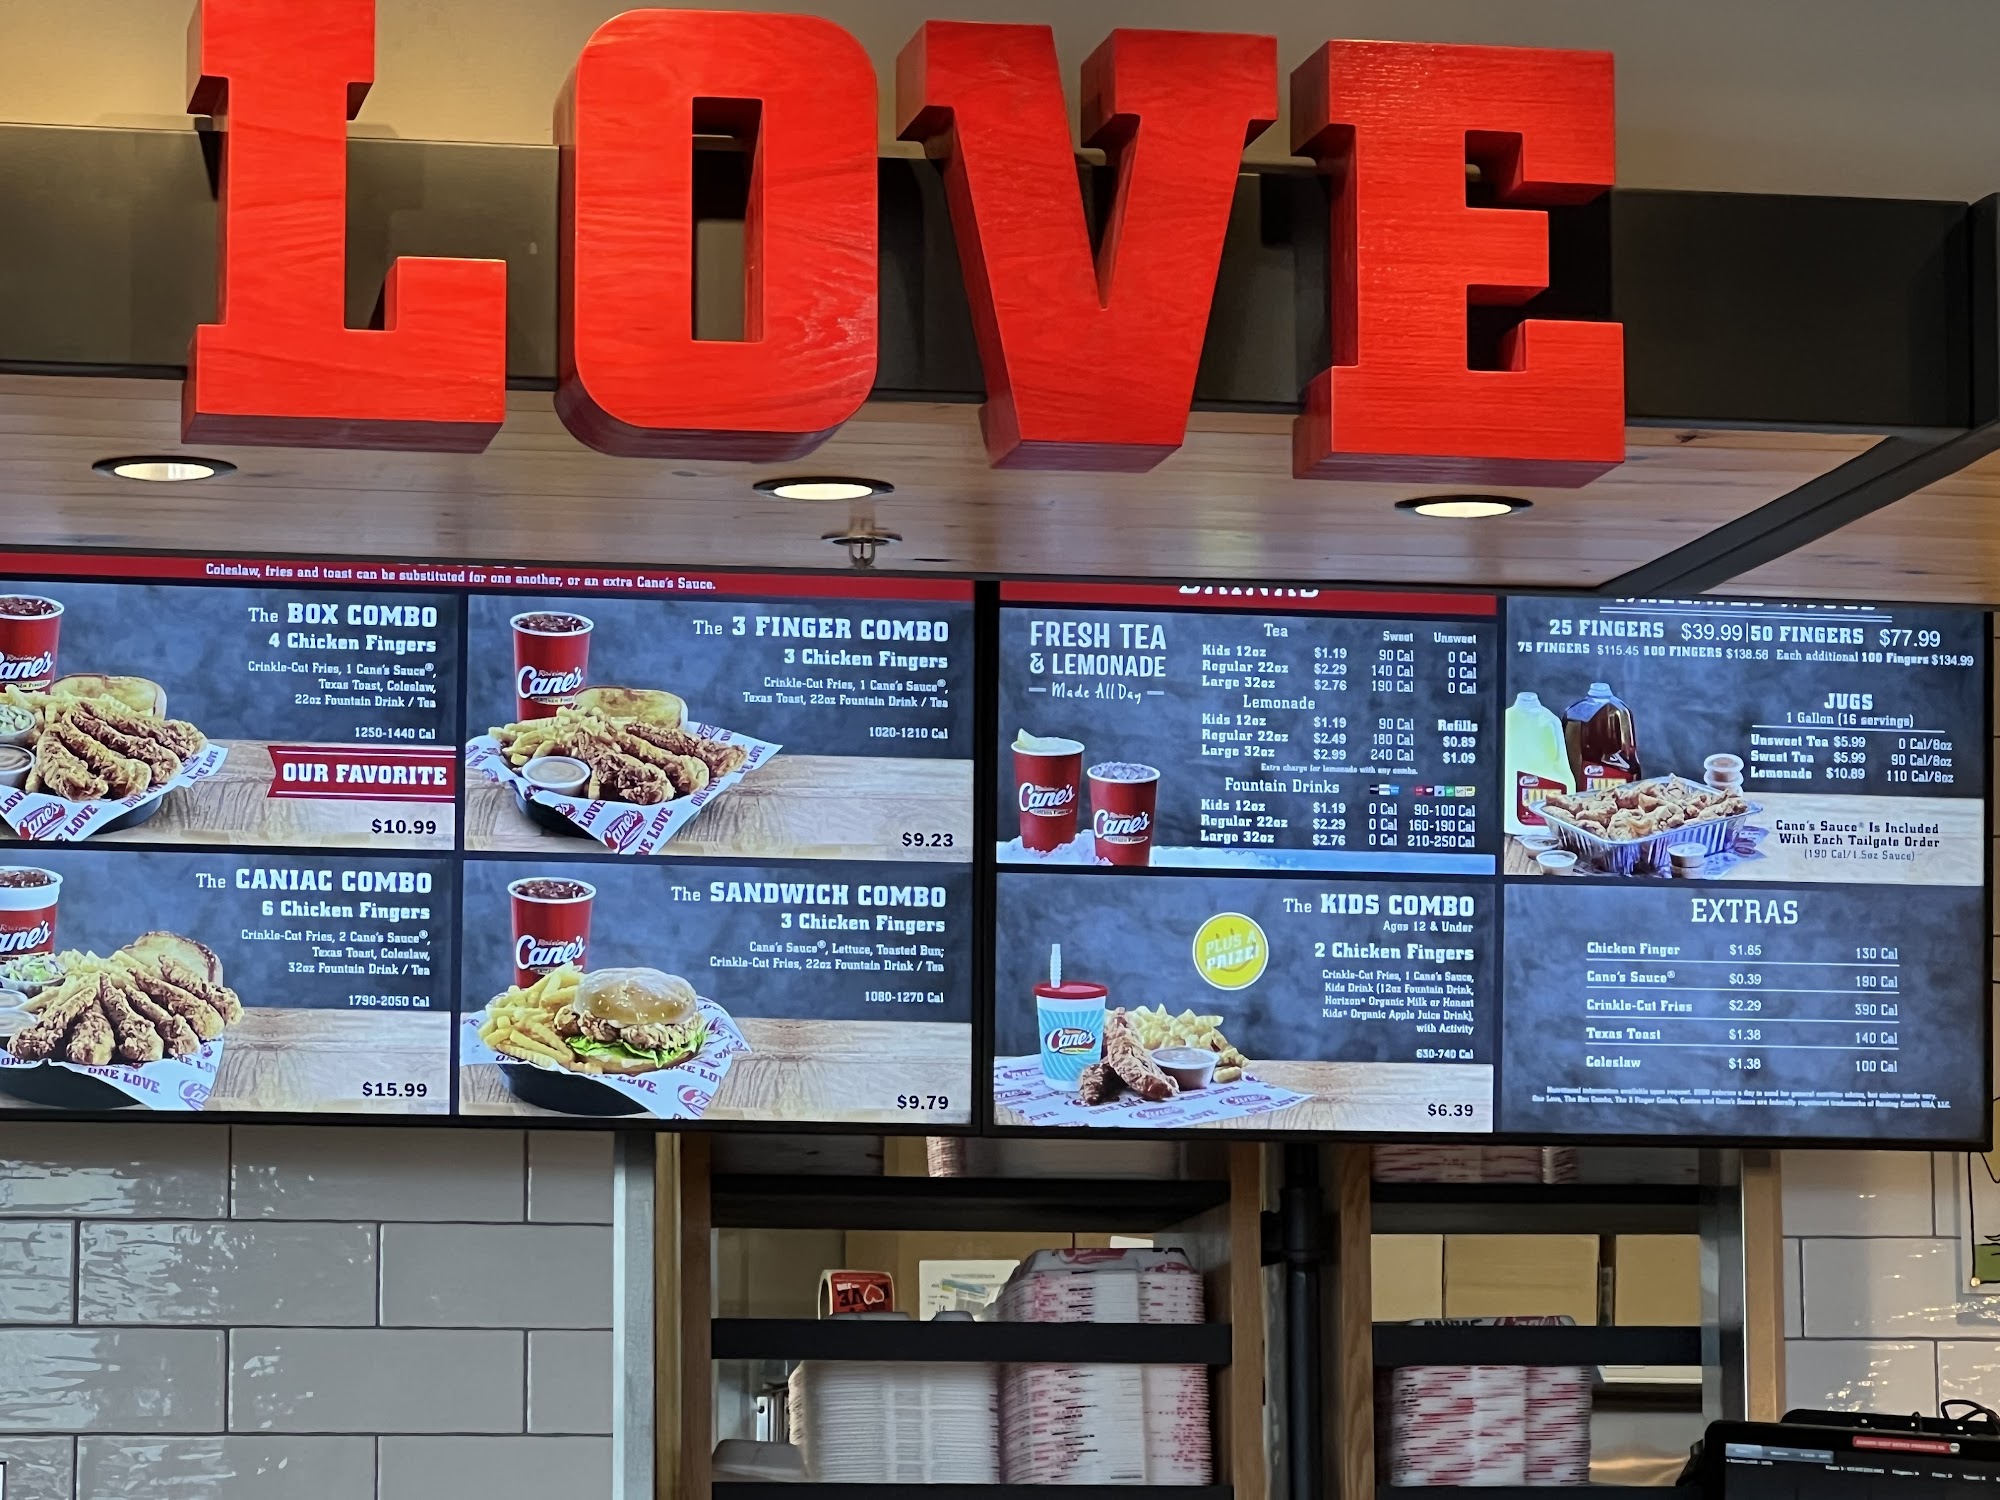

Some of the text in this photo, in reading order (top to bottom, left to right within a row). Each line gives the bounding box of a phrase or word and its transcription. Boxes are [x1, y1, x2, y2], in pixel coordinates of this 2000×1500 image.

[180, 0, 1626, 488] LOVE
[206, 563, 716, 590] Coleslaw, fries and toast can be substituted for one another, or an extra Cane's Sauce.
[248, 603, 438, 627] The BOX COMBO
[693, 616, 949, 642] The 3 FINGER COMBO
[1030, 621, 1166, 650] FRESH TEA
[1264, 623, 1288, 638] Tea
[1550, 619, 1664, 638] 25 FINGERS
[1682, 622, 1742, 642] $39.99
[1750, 625, 1941, 648] 50 FINGERS $77.99
[269, 632, 436, 655] 4 Chicken Fingers
[248, 661, 308, 673] Crinkle-Cut
[312, 663, 342, 675] Fries,
[346, 664, 352, 674] 1
[356, 664, 390, 676] Cane's
[784, 649, 948, 672] 3 Chicken Fingers
[1030, 652, 1166, 677] & LEMONADE
[1202, 660, 1476, 680] Regular 22oz $2.29 140 Cal 0 Cal
[318, 679, 437, 694] Texas Toast, Coleslaw,
[517, 666, 583, 698] Cane's
[1052, 682, 1142, 704] Made All Day
[1824, 693, 1873, 710] JUGS
[1243, 695, 1316, 710] Lemonade
[1438, 719, 1478, 732] Refills
[1786, 712, 1914, 729] 1 Gallon (16 servings)
[356, 727, 436, 740] 1250-1440 Cal
[869, 727, 948, 739] 1020-1210 Cal
[1202, 730, 1476, 748] Regular 22oz $2.49 180 Cal $0.89
[1443, 752, 1476, 764] $1.09
[282, 763, 447, 786] OUR FAVORITE
[1750, 766, 1954, 784] Lemonade $10.89 110 Cal/8oz
[1225, 778, 1340, 794] Fountain Drinks
[1019, 782, 1075, 812] Cane's
[372, 818, 436, 834] $10.99
[1094, 809, 1150, 838] Cane's
[902, 832, 954, 847] $9.23
[1200, 830, 1476, 848] Large 32oz $2.76 0 Cal 210-250 Cal
[1779, 833, 1940, 848] With Each Tailgate Order
[196, 868, 432, 894] The CANIAC COMBO
[671, 882, 946, 908] The SANDWICH COMBO
[262, 900, 430, 922] 6 Chicken Fingers
[1283, 894, 1474, 917] The KIDS COMBO
[1691, 898, 1799, 925] EXTRAS
[781, 914, 945, 935] 3 Chicken Fingers
[1383, 921, 1474, 934] Ages 12 & Under
[516, 935, 586, 970] Cane's
[750, 941, 782, 954] Cane's
[832, 943, 873, 957] Lettuce,
[876, 944, 916, 956] Toasted
[920, 945, 944, 958] Bun;
[1314, 942, 1474, 964] 2 Chicken Fingers
[1587, 942, 1898, 960] Chicken Finger $1.85 130 Cal
[288, 962, 430, 976] 32oz Fountain Drink / Tea
[349, 995, 430, 1008] 1790-2050 Cal
[865, 992, 944, 1004] 1080-1270 Cal
[1586, 1055, 1898, 1073] Coleslaw $1.38 100 Cal
[362, 1082, 427, 1097] $15.99
[897, 1095, 949, 1110] $9.79
[1428, 1103, 1474, 1118] $6.39
